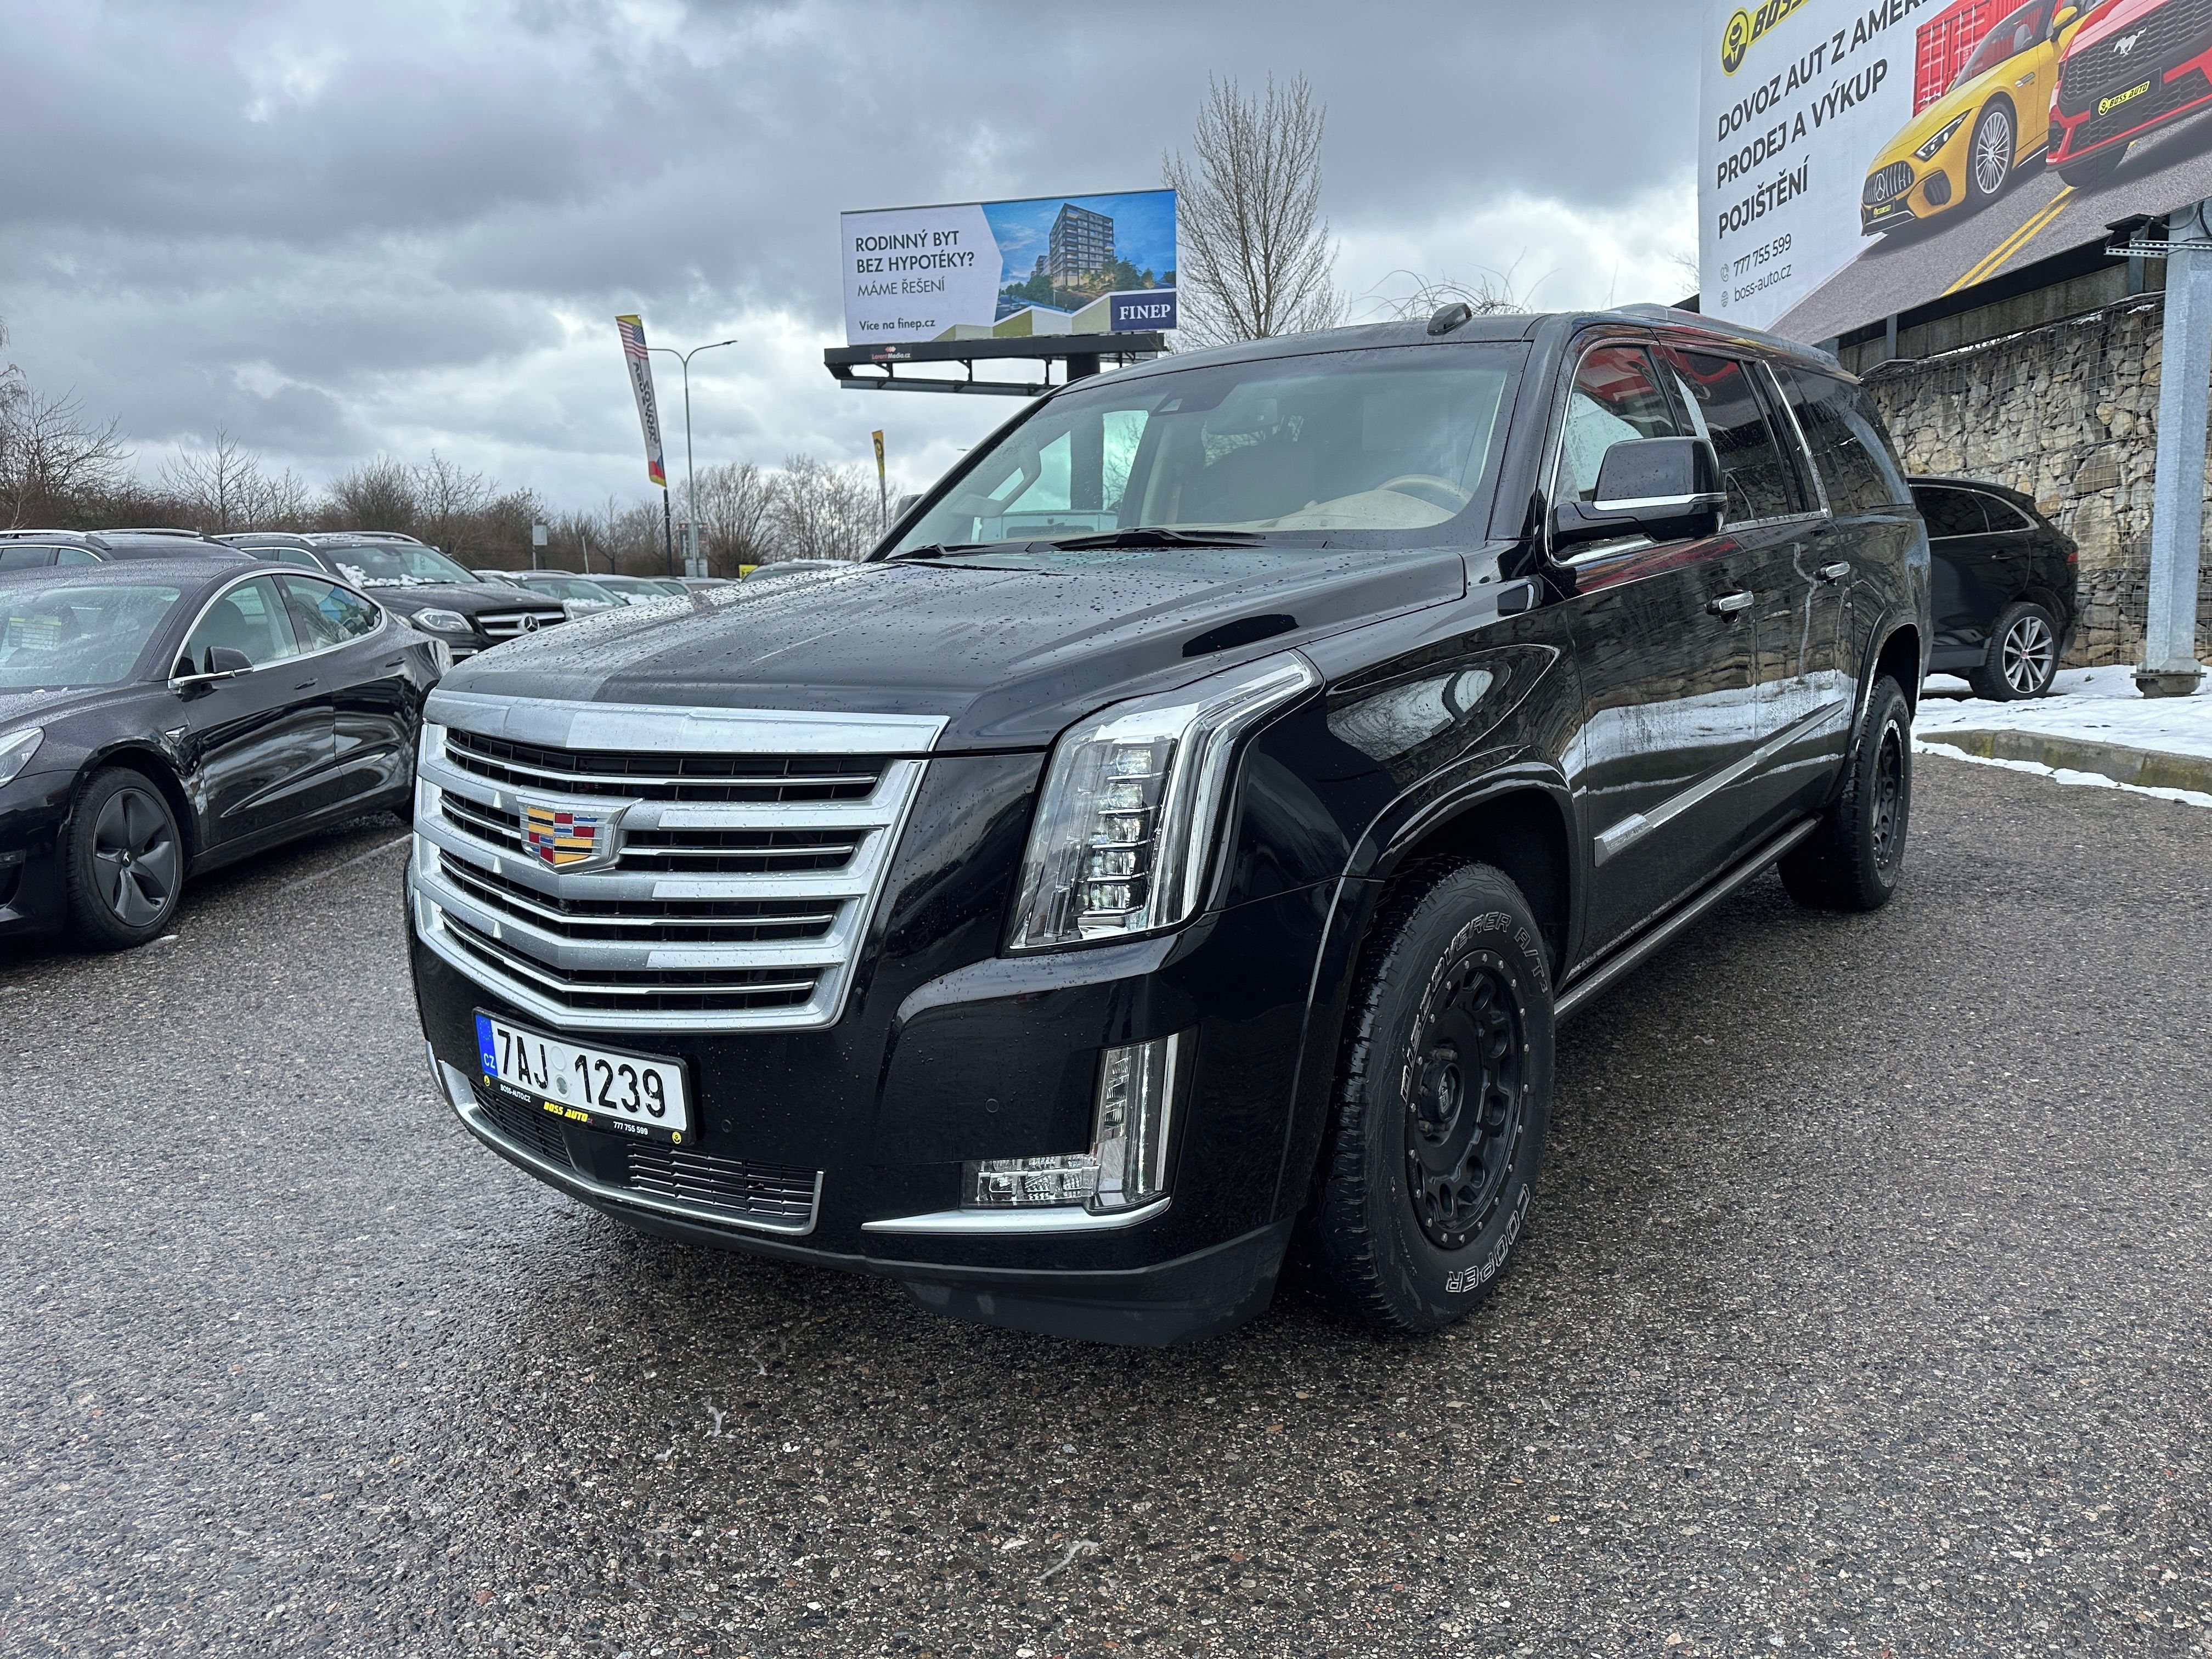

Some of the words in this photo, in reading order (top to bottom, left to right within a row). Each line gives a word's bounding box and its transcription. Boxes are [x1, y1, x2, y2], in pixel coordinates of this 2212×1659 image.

[1750, 0, 1802, 42] BOS
[1718, 74, 1781, 142] DOVOZ
[1784, 42, 1827, 97] AUT
[1831, 29, 1846, 65] Z
[1849, 0, 1927, 53] AME
[2109, 93, 2127, 107] BOSS
[2128, 82, 2148, 99] AUTO
[1717, 121, 1787, 190] PRODEJ
[1791, 111, 1807, 144] A
[1811, 58, 1888, 128] VÝKUP
[1718, 154, 1810, 239] POJIŠTĚNÍ
[856, 229, 928, 252] RODINNÝ
[933, 230, 959, 247] BYT
[857, 258, 883, 273] BEZ
[889, 249, 974, 272] HYPOTÉKY?
[1734, 253, 1751, 276] 777
[1753, 244, 1770, 267] 755
[1773, 233, 1791, 257] 599
[857, 280, 898, 296] MÁME
[902, 276, 945, 294] ŘEŠENÍ
[1734, 264, 1792, 302] boss-auto.cz
[1119, 304, 1171, 320] FINEP
[859, 320, 879, 331] Více
[883, 321, 895, 330] na
[898, 318, 935, 331] finep.cz
[483, 1052, 496, 1070] CZ
[496, 1028, 549, 1090] 7AJ
[574, 1054, 667, 1118] 1239
[500, 1084, 531, 1103] BOSS-AUTO.CZ
[543, 1101, 563, 1115] BOSS
[565, 1110, 588, 1122] AUTO
[613, 1121, 624, 1129] 777
[624, 1124, 636, 1132] 755
[636, 1126, 648, 1135] 599
[1446, 1183, 1531, 1293] COOPER
